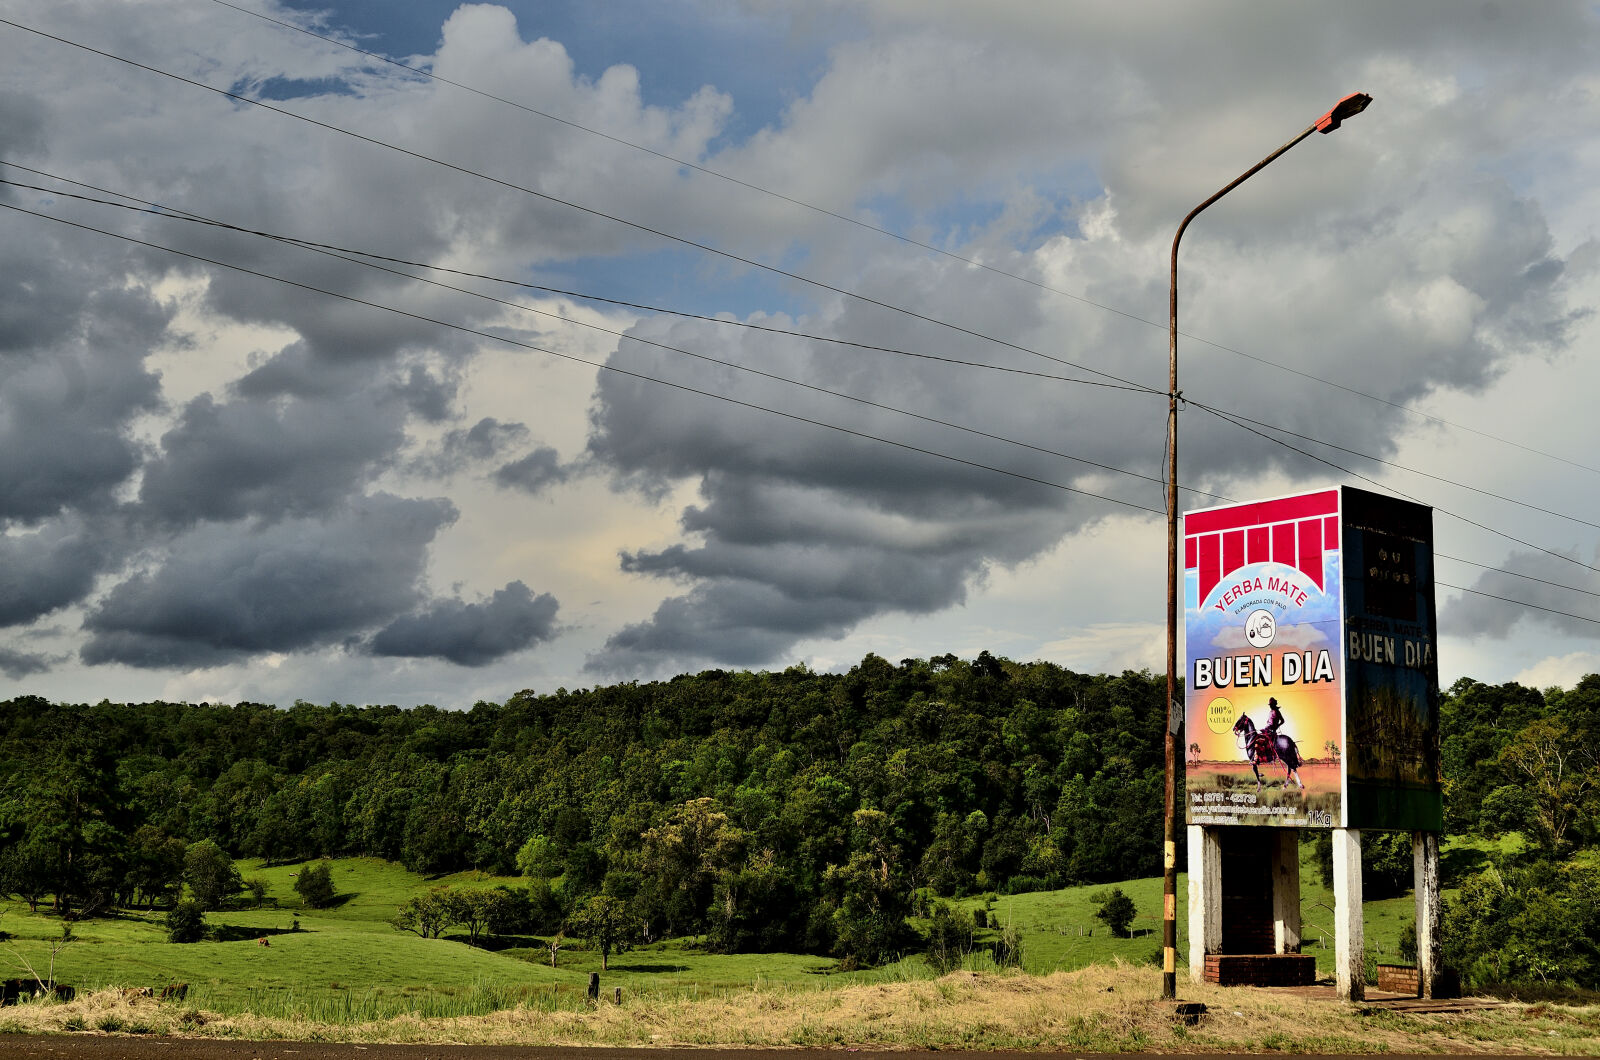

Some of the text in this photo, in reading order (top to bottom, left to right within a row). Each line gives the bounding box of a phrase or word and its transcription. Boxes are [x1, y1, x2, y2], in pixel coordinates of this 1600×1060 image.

[1215, 576, 1308, 612] YERBA MATE
[1234, 599, 1262, 615] ELABORADA
[1275, 600, 1287, 610] PALO
[1349, 631, 1434, 669] BUEN DIA
[1194, 649, 1335, 690] BUEN DIA
[1210, 706, 1232, 715] 100%
